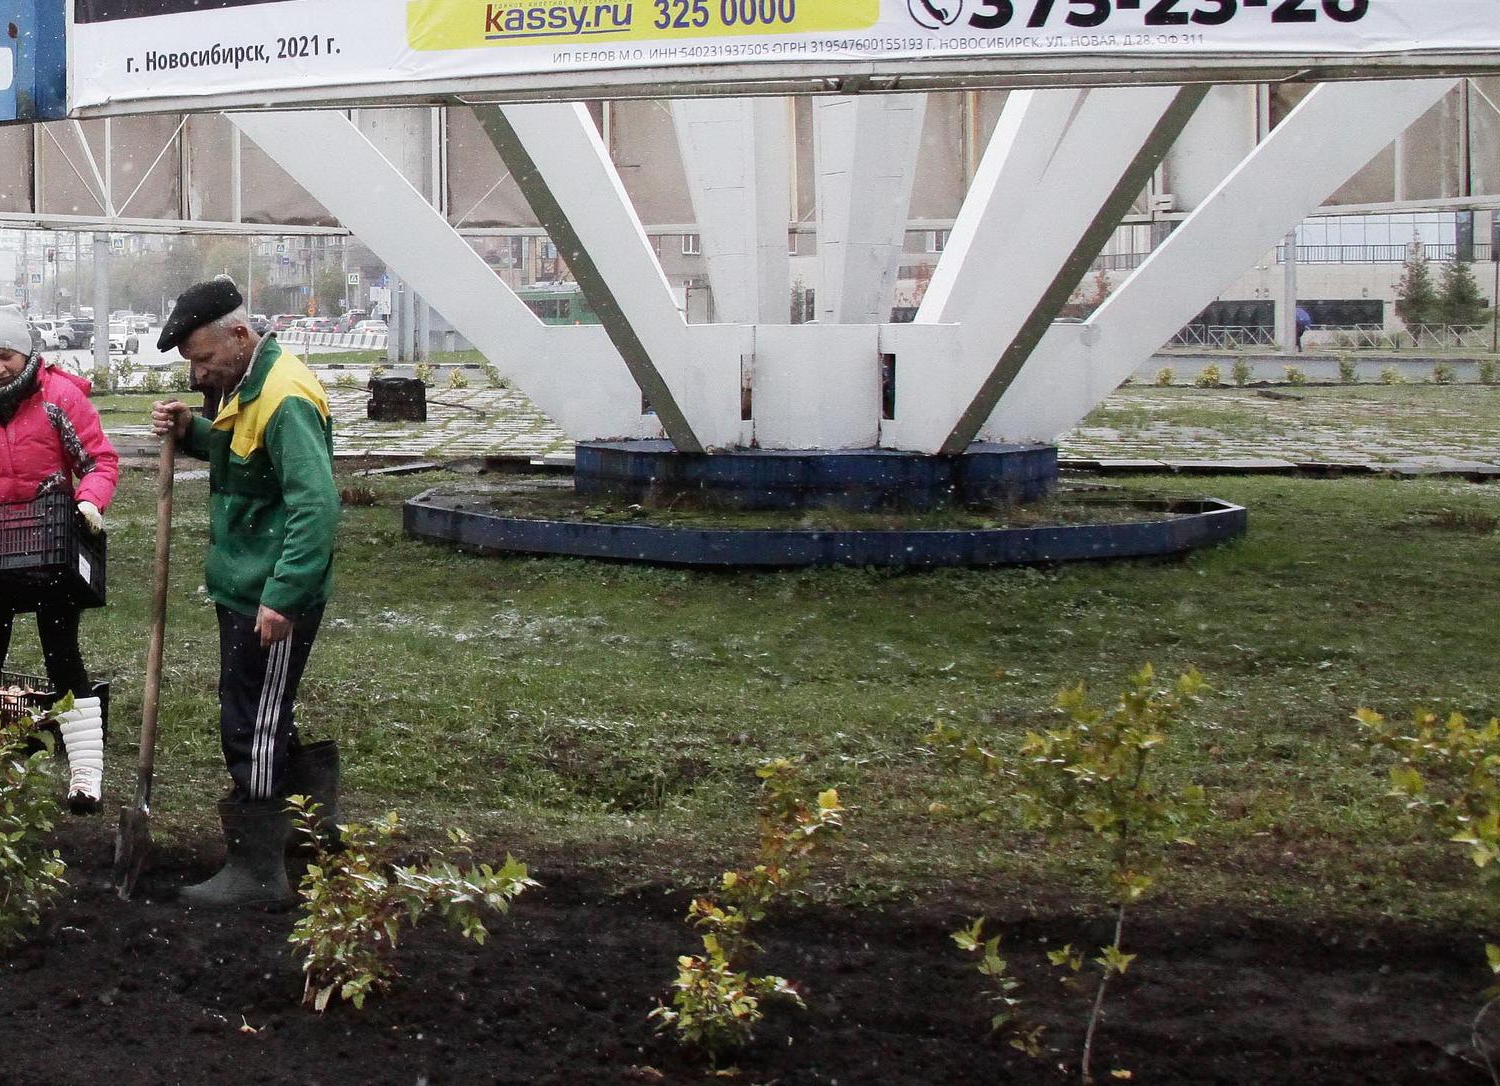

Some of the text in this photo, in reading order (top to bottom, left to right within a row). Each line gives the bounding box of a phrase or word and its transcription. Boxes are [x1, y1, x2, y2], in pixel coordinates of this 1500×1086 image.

[485, 4, 632, 35] kassy.ru
[654, 0, 795, 29] 325 0000
[126, 34, 341, 73] г. Новосибирск, 2021 г.
[553, 54, 570, 64] ИП
[575, 51, 616, 63] БЕЛОВ
[650, 48, 677, 59] ИНН
[772, 42, 807, 53] ОГРН
